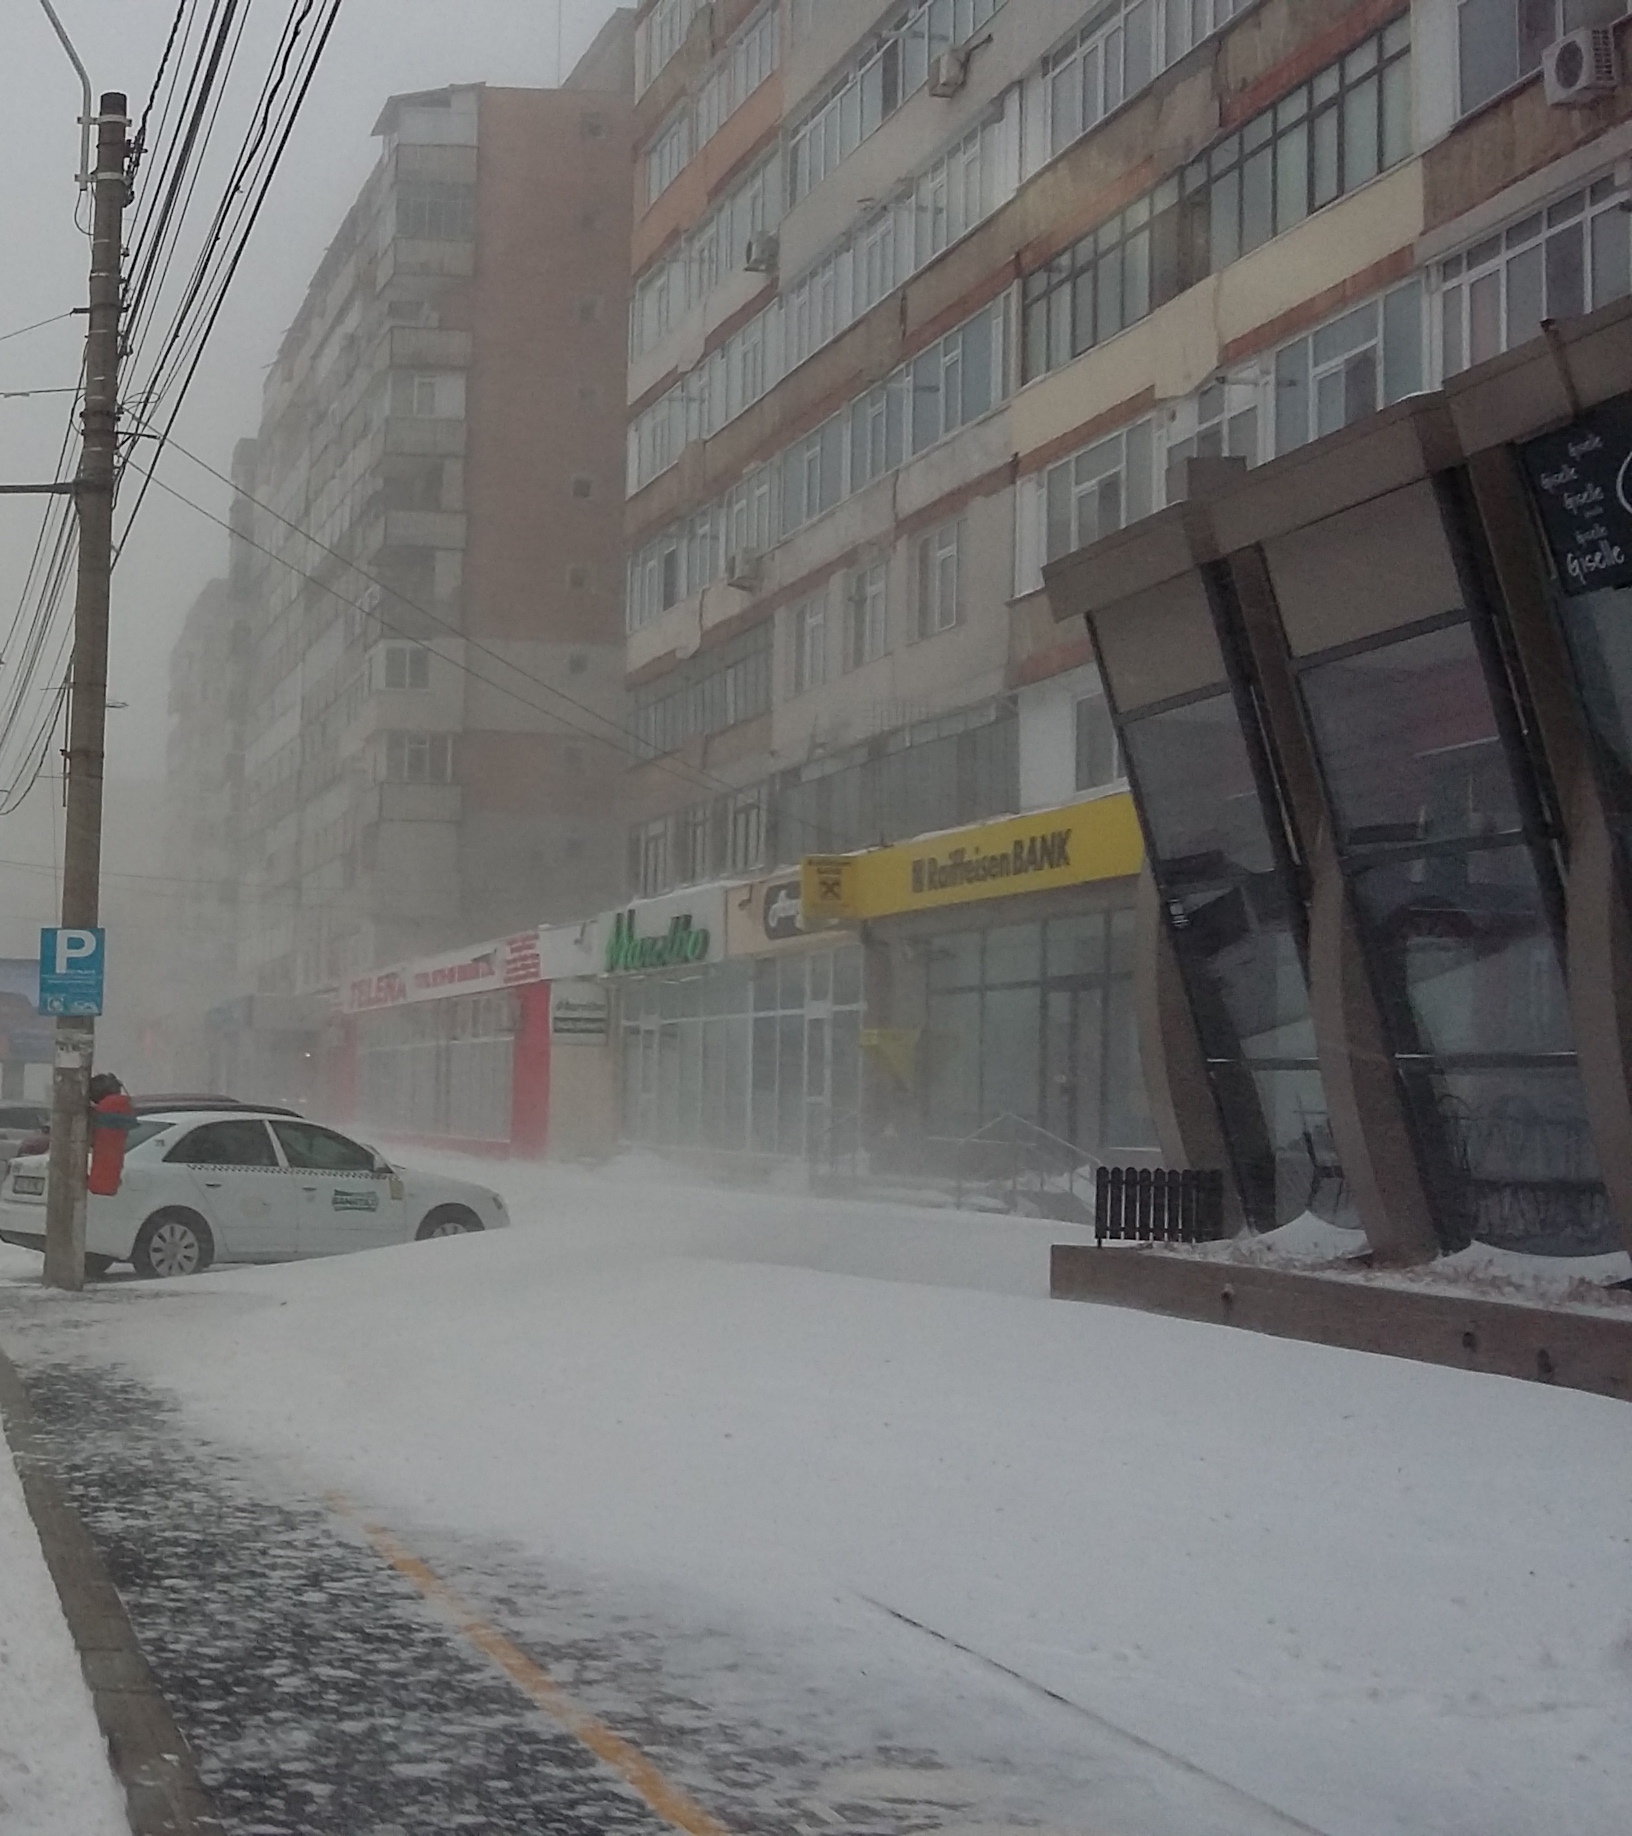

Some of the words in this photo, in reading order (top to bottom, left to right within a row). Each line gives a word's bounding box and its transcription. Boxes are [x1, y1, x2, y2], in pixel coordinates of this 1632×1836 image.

[927, 846, 1011, 892] Raiffeisen
[1013, 828, 1072, 876] BANK
[56, 930, 96, 974] P
